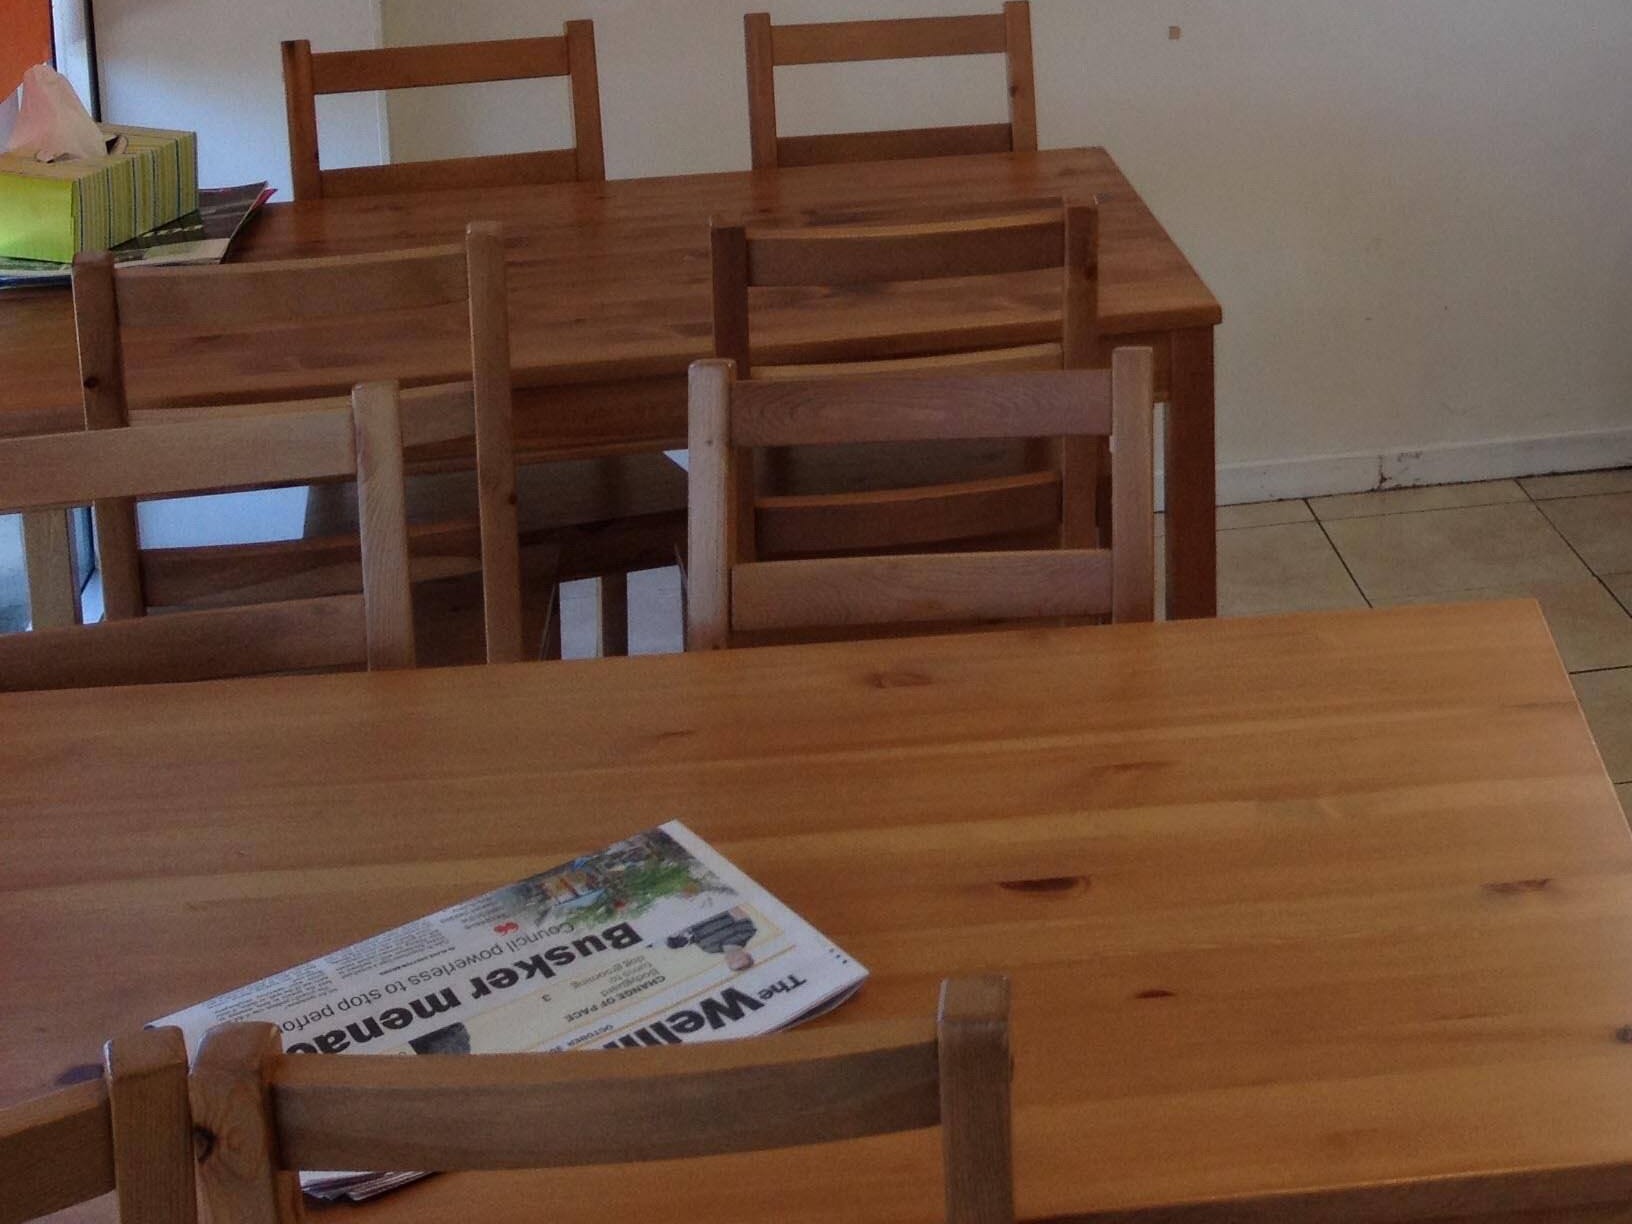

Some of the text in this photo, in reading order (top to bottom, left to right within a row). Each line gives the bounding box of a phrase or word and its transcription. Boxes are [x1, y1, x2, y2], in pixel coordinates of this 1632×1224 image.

[506, 922, 575, 954] Council
[408, 944, 504, 986] powerless
[469, 922, 643, 1000] Busker
[337, 988, 383, 1012] stop
[384, 979, 407, 995] to
[758, 974, 808, 1002] The
[280, 1003, 335, 1034] perfo
